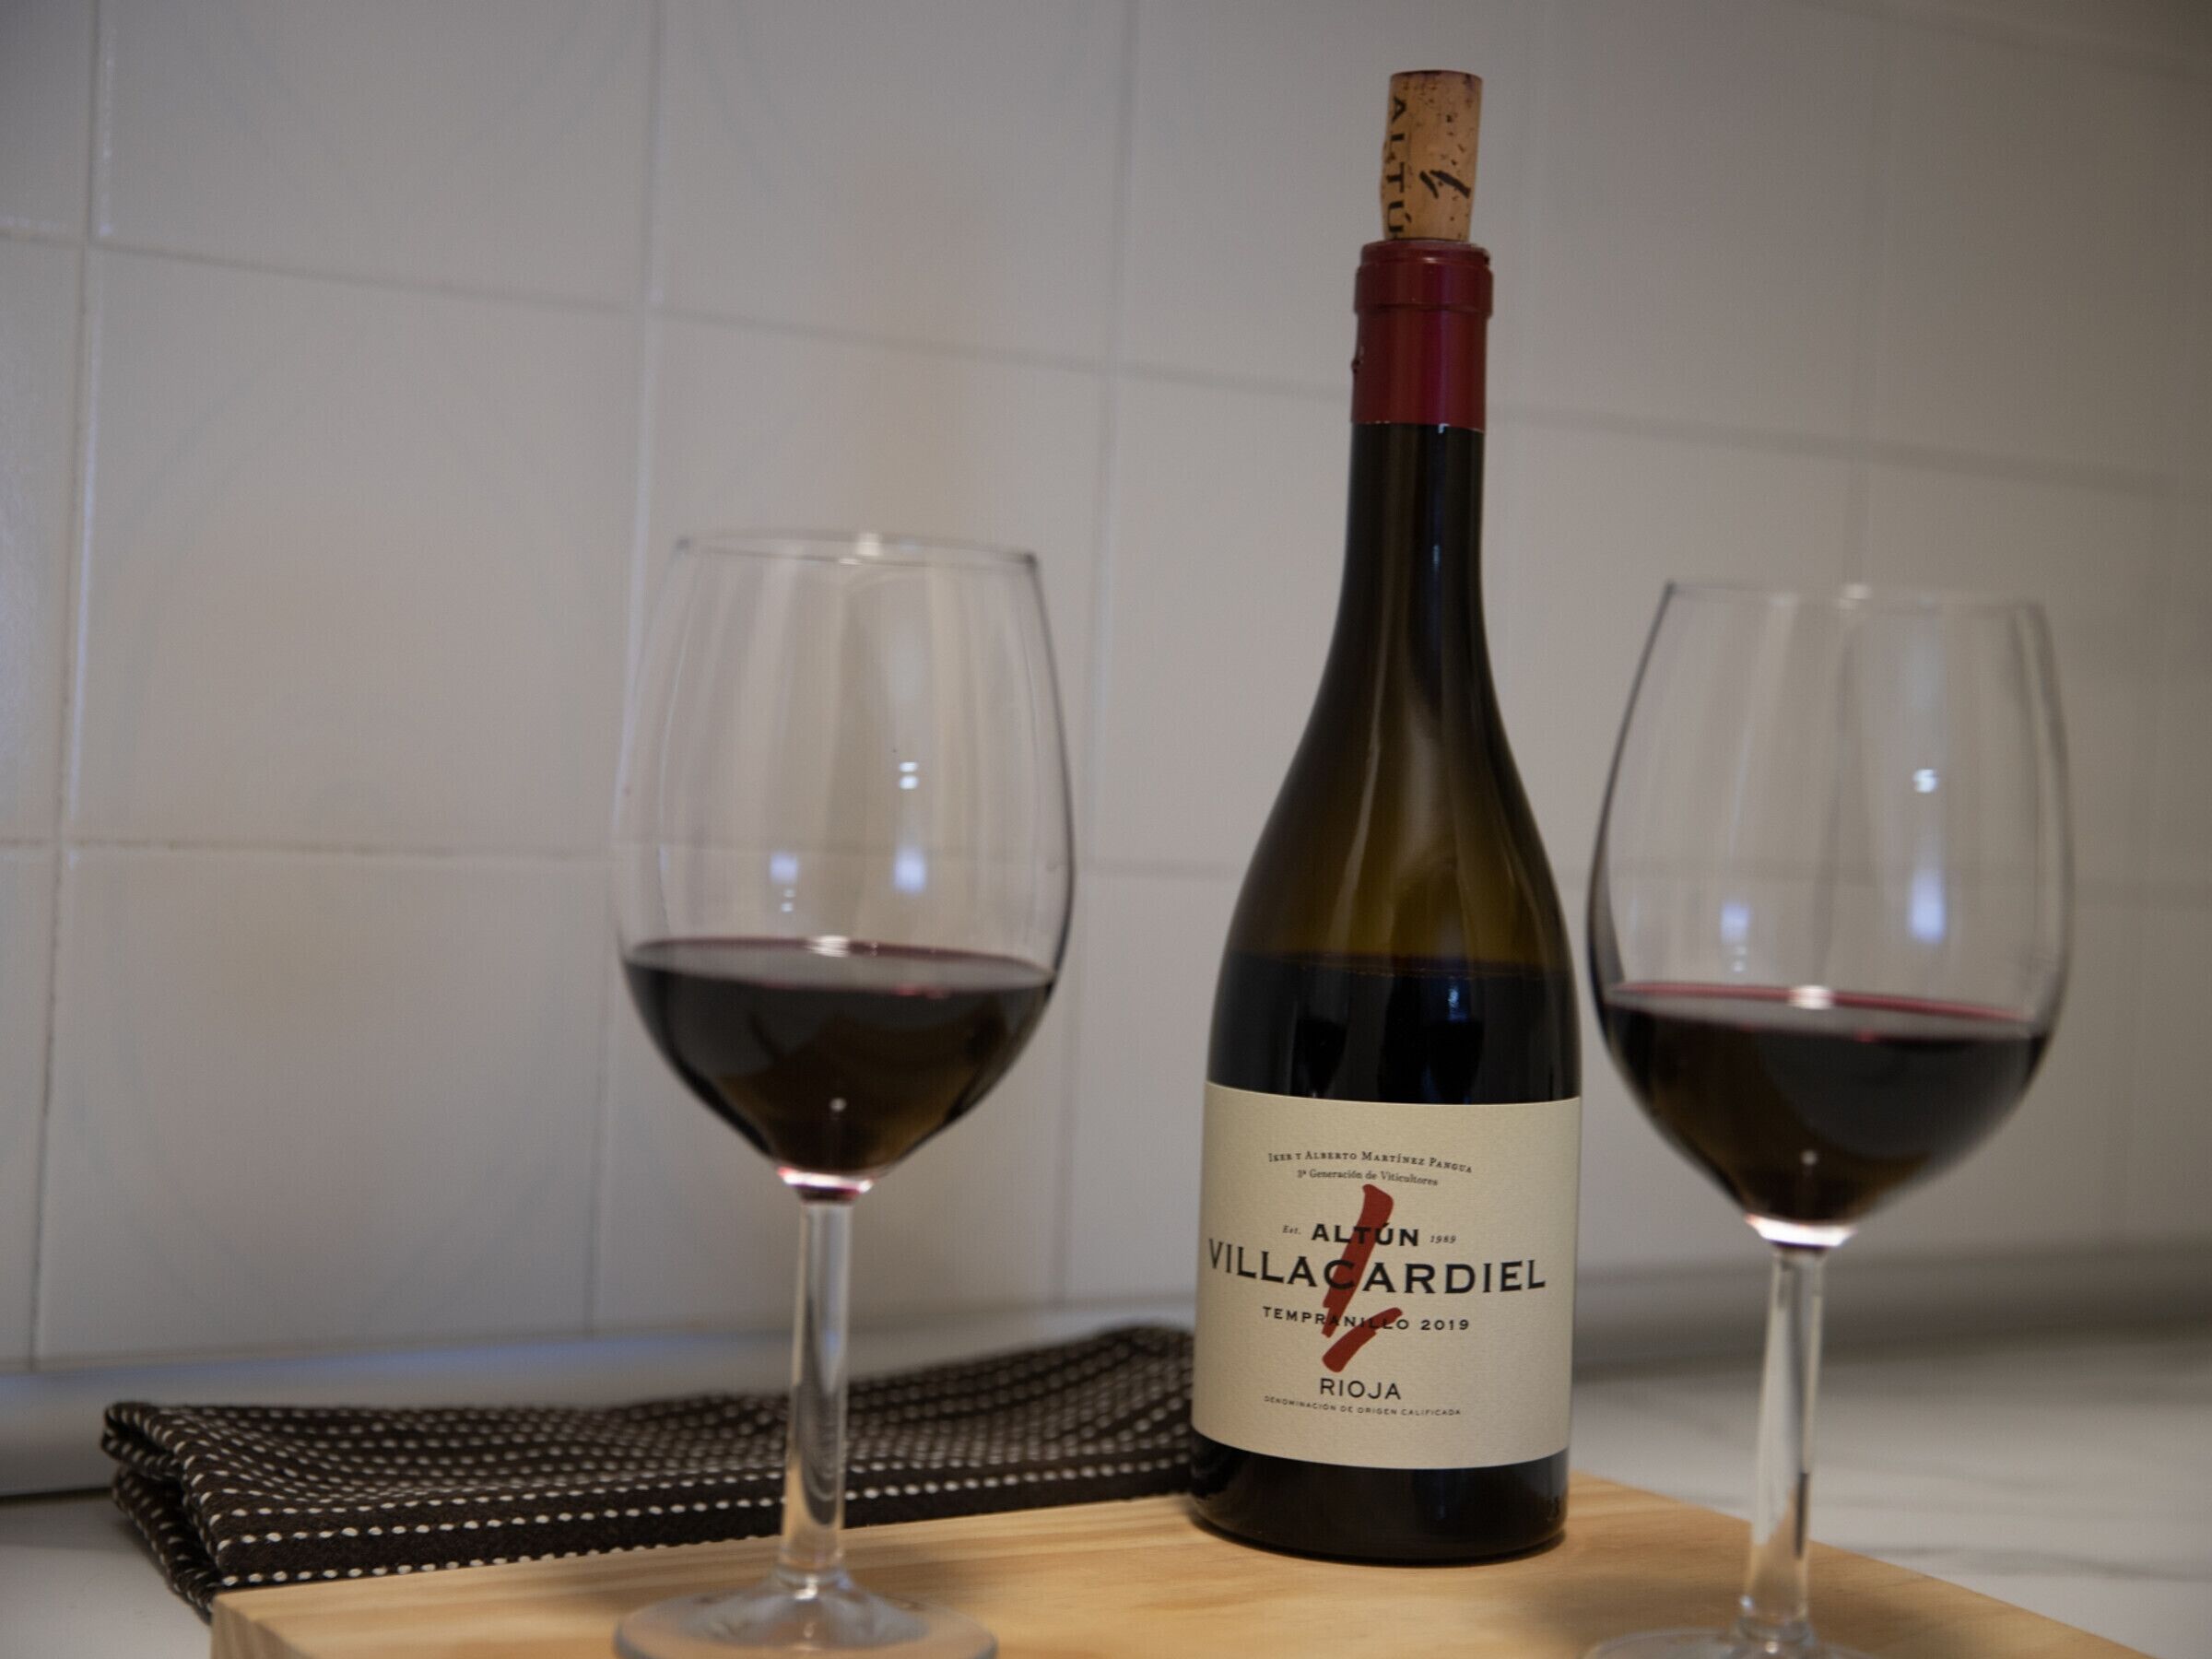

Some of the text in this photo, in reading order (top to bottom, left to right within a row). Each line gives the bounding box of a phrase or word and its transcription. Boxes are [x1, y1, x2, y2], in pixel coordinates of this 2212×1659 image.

[1310, 1168, 1363, 1179] Generación
[1365, 1171, 1377, 1180] de
[1381, 1171, 1438, 1186] Viticultores
[1311, 1222, 1419, 1247] ALTÚN
[1208, 1238, 1546, 1294] VILLACARDIEL
[1263, 1305, 1469, 1330] TEMPRANILLO 2019
[1320, 1378, 1401, 1400] RIOJA
[1357, 1406, 1397, 1415] ORIGEN
